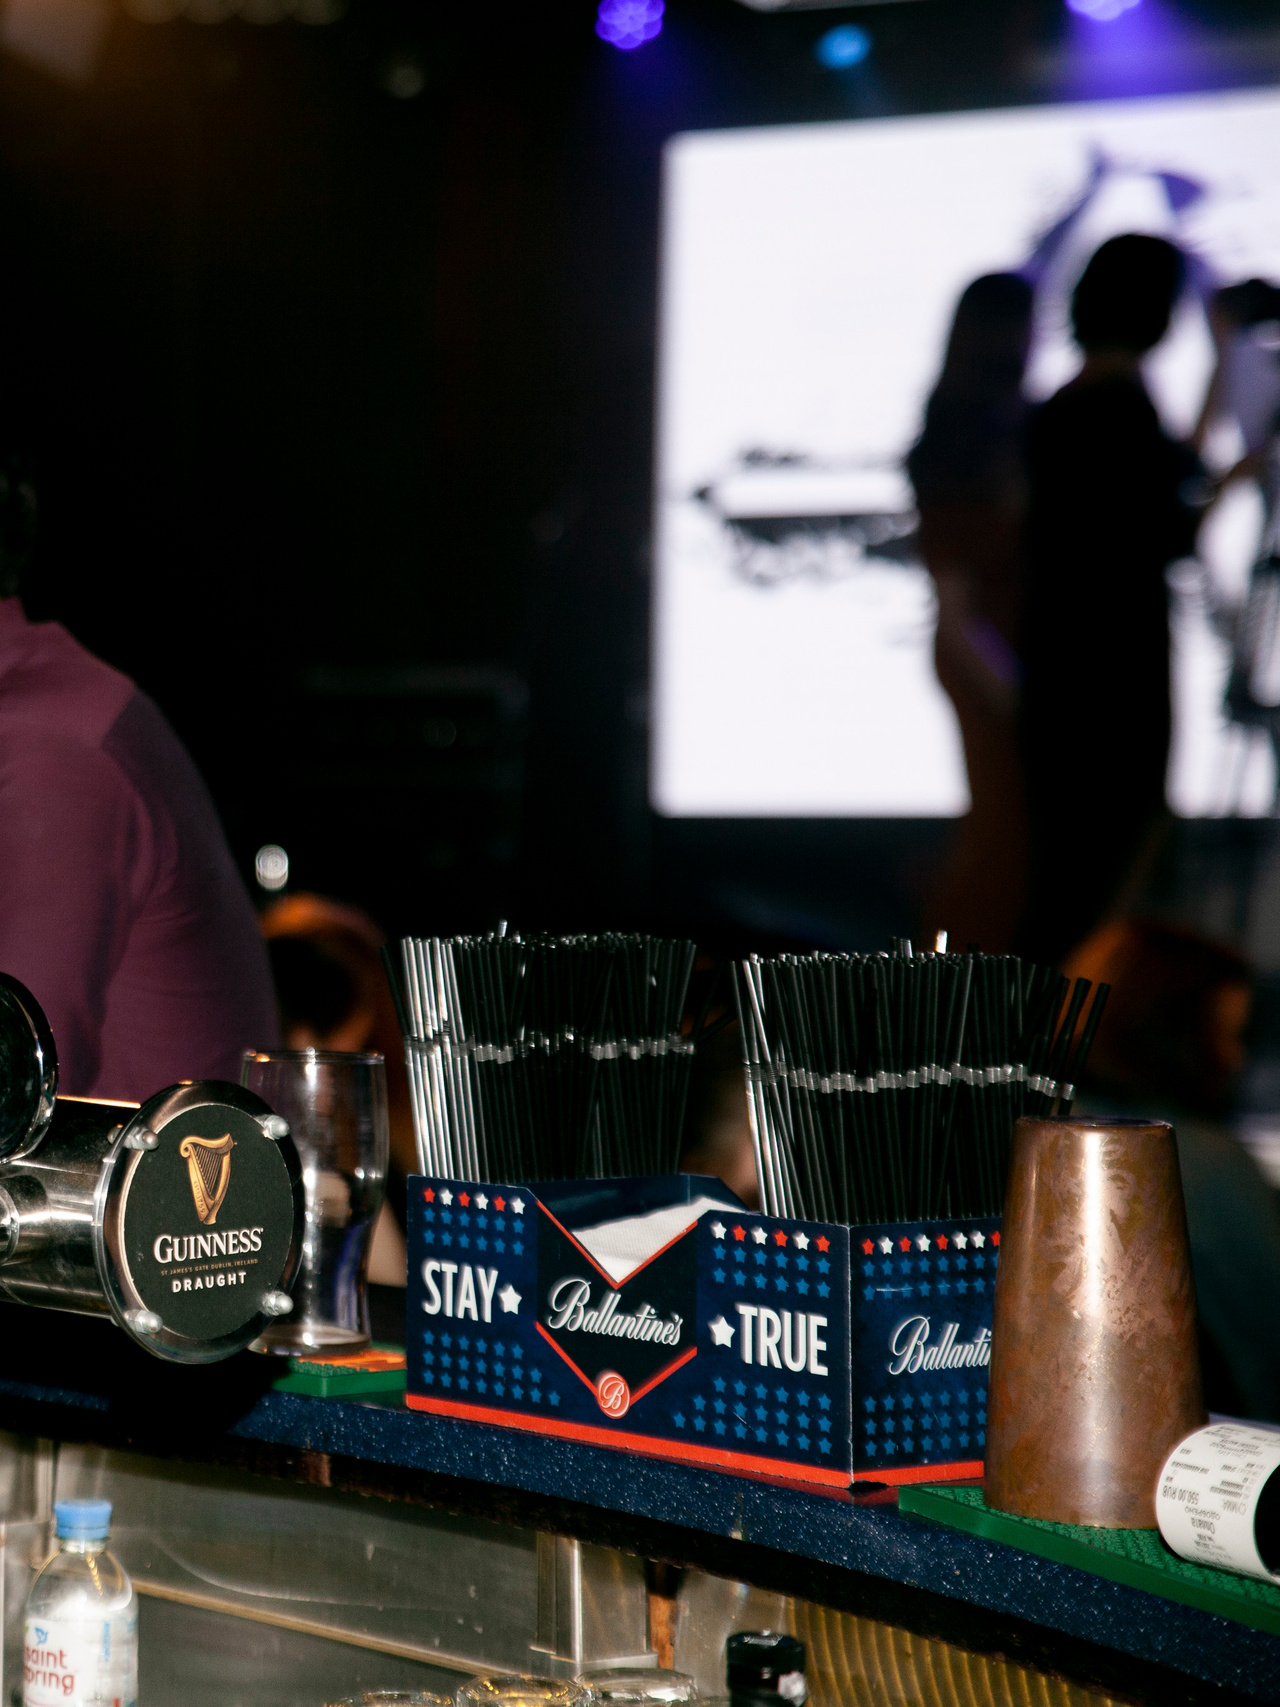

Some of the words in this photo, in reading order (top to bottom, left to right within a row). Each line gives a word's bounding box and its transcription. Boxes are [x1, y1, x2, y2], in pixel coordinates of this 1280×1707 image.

[153, 1227, 263, 1264] GUINNESS
[194, 1264, 210, 1272] GATE
[234, 1258, 259, 1267] IRELAND
[172, 1271, 247, 1294] DRAUGHT
[423, 1259, 498, 1323] STAY
[548, 1275, 684, 1346] Ballantine's
[736, 1303, 829, 1377] TRUE
[1162, 1485, 1178, 1500] RUB
[1184, 1506, 1221, 1521] ОДОБРЕНО
